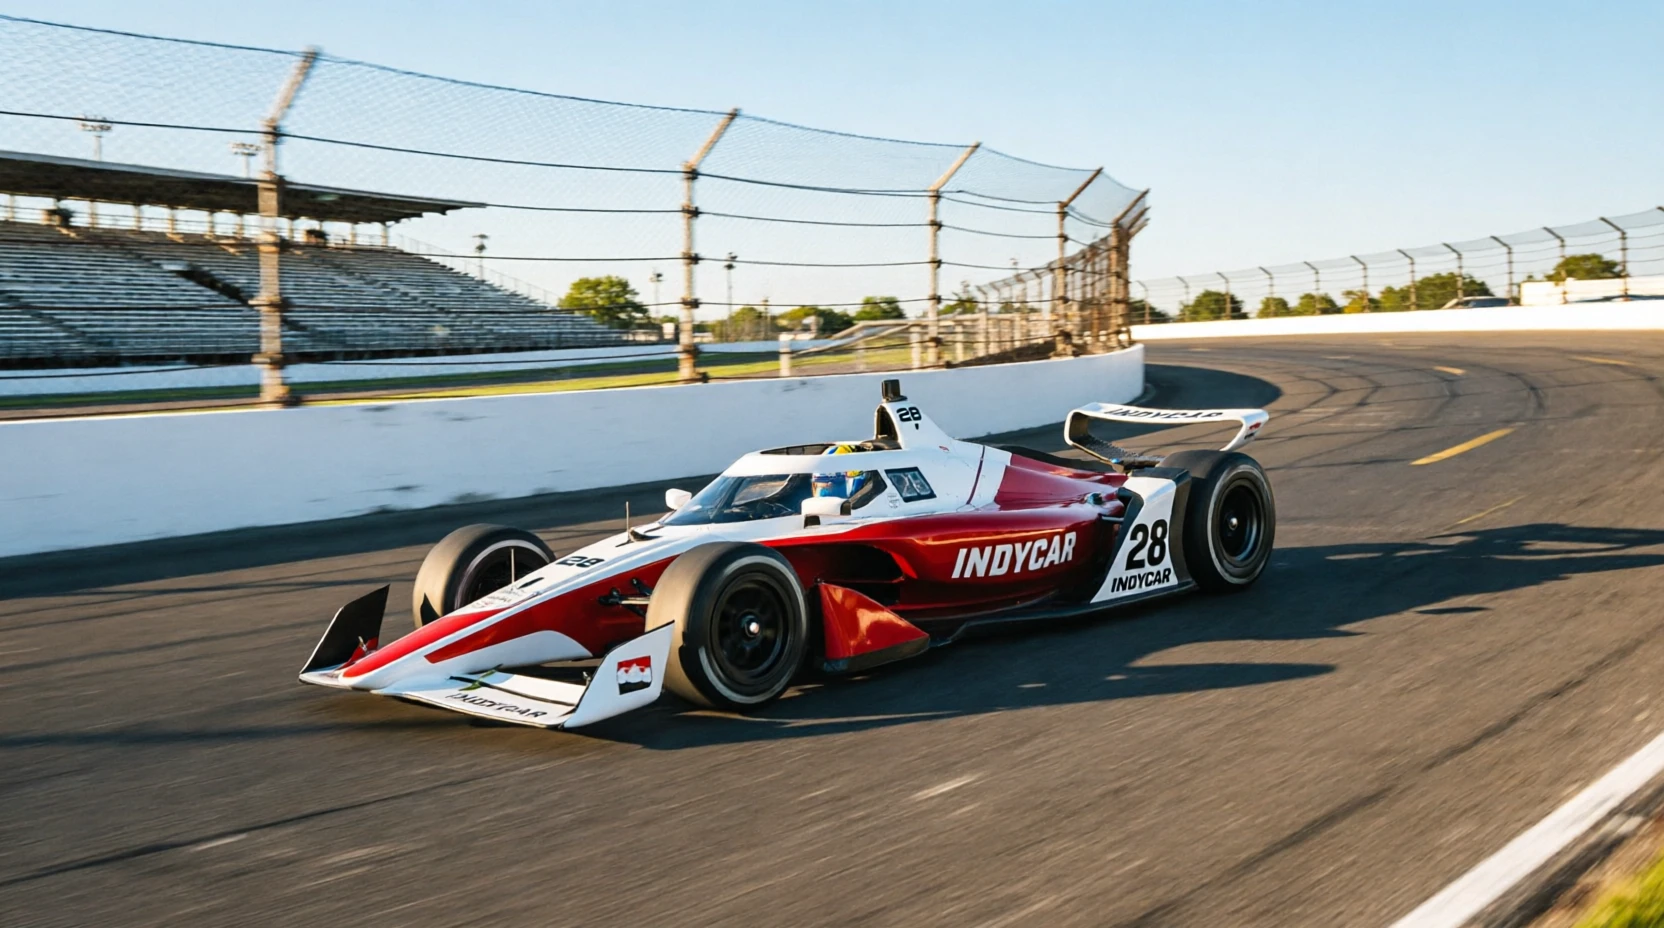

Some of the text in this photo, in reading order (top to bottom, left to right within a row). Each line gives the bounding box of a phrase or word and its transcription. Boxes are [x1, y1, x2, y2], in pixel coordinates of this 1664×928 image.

[896, 406, 922, 422] 28
[951, 531, 1077, 579] INDYCAR
[1125, 519, 1168, 571] 28
[1111, 568, 1172, 593] INDYCAR
